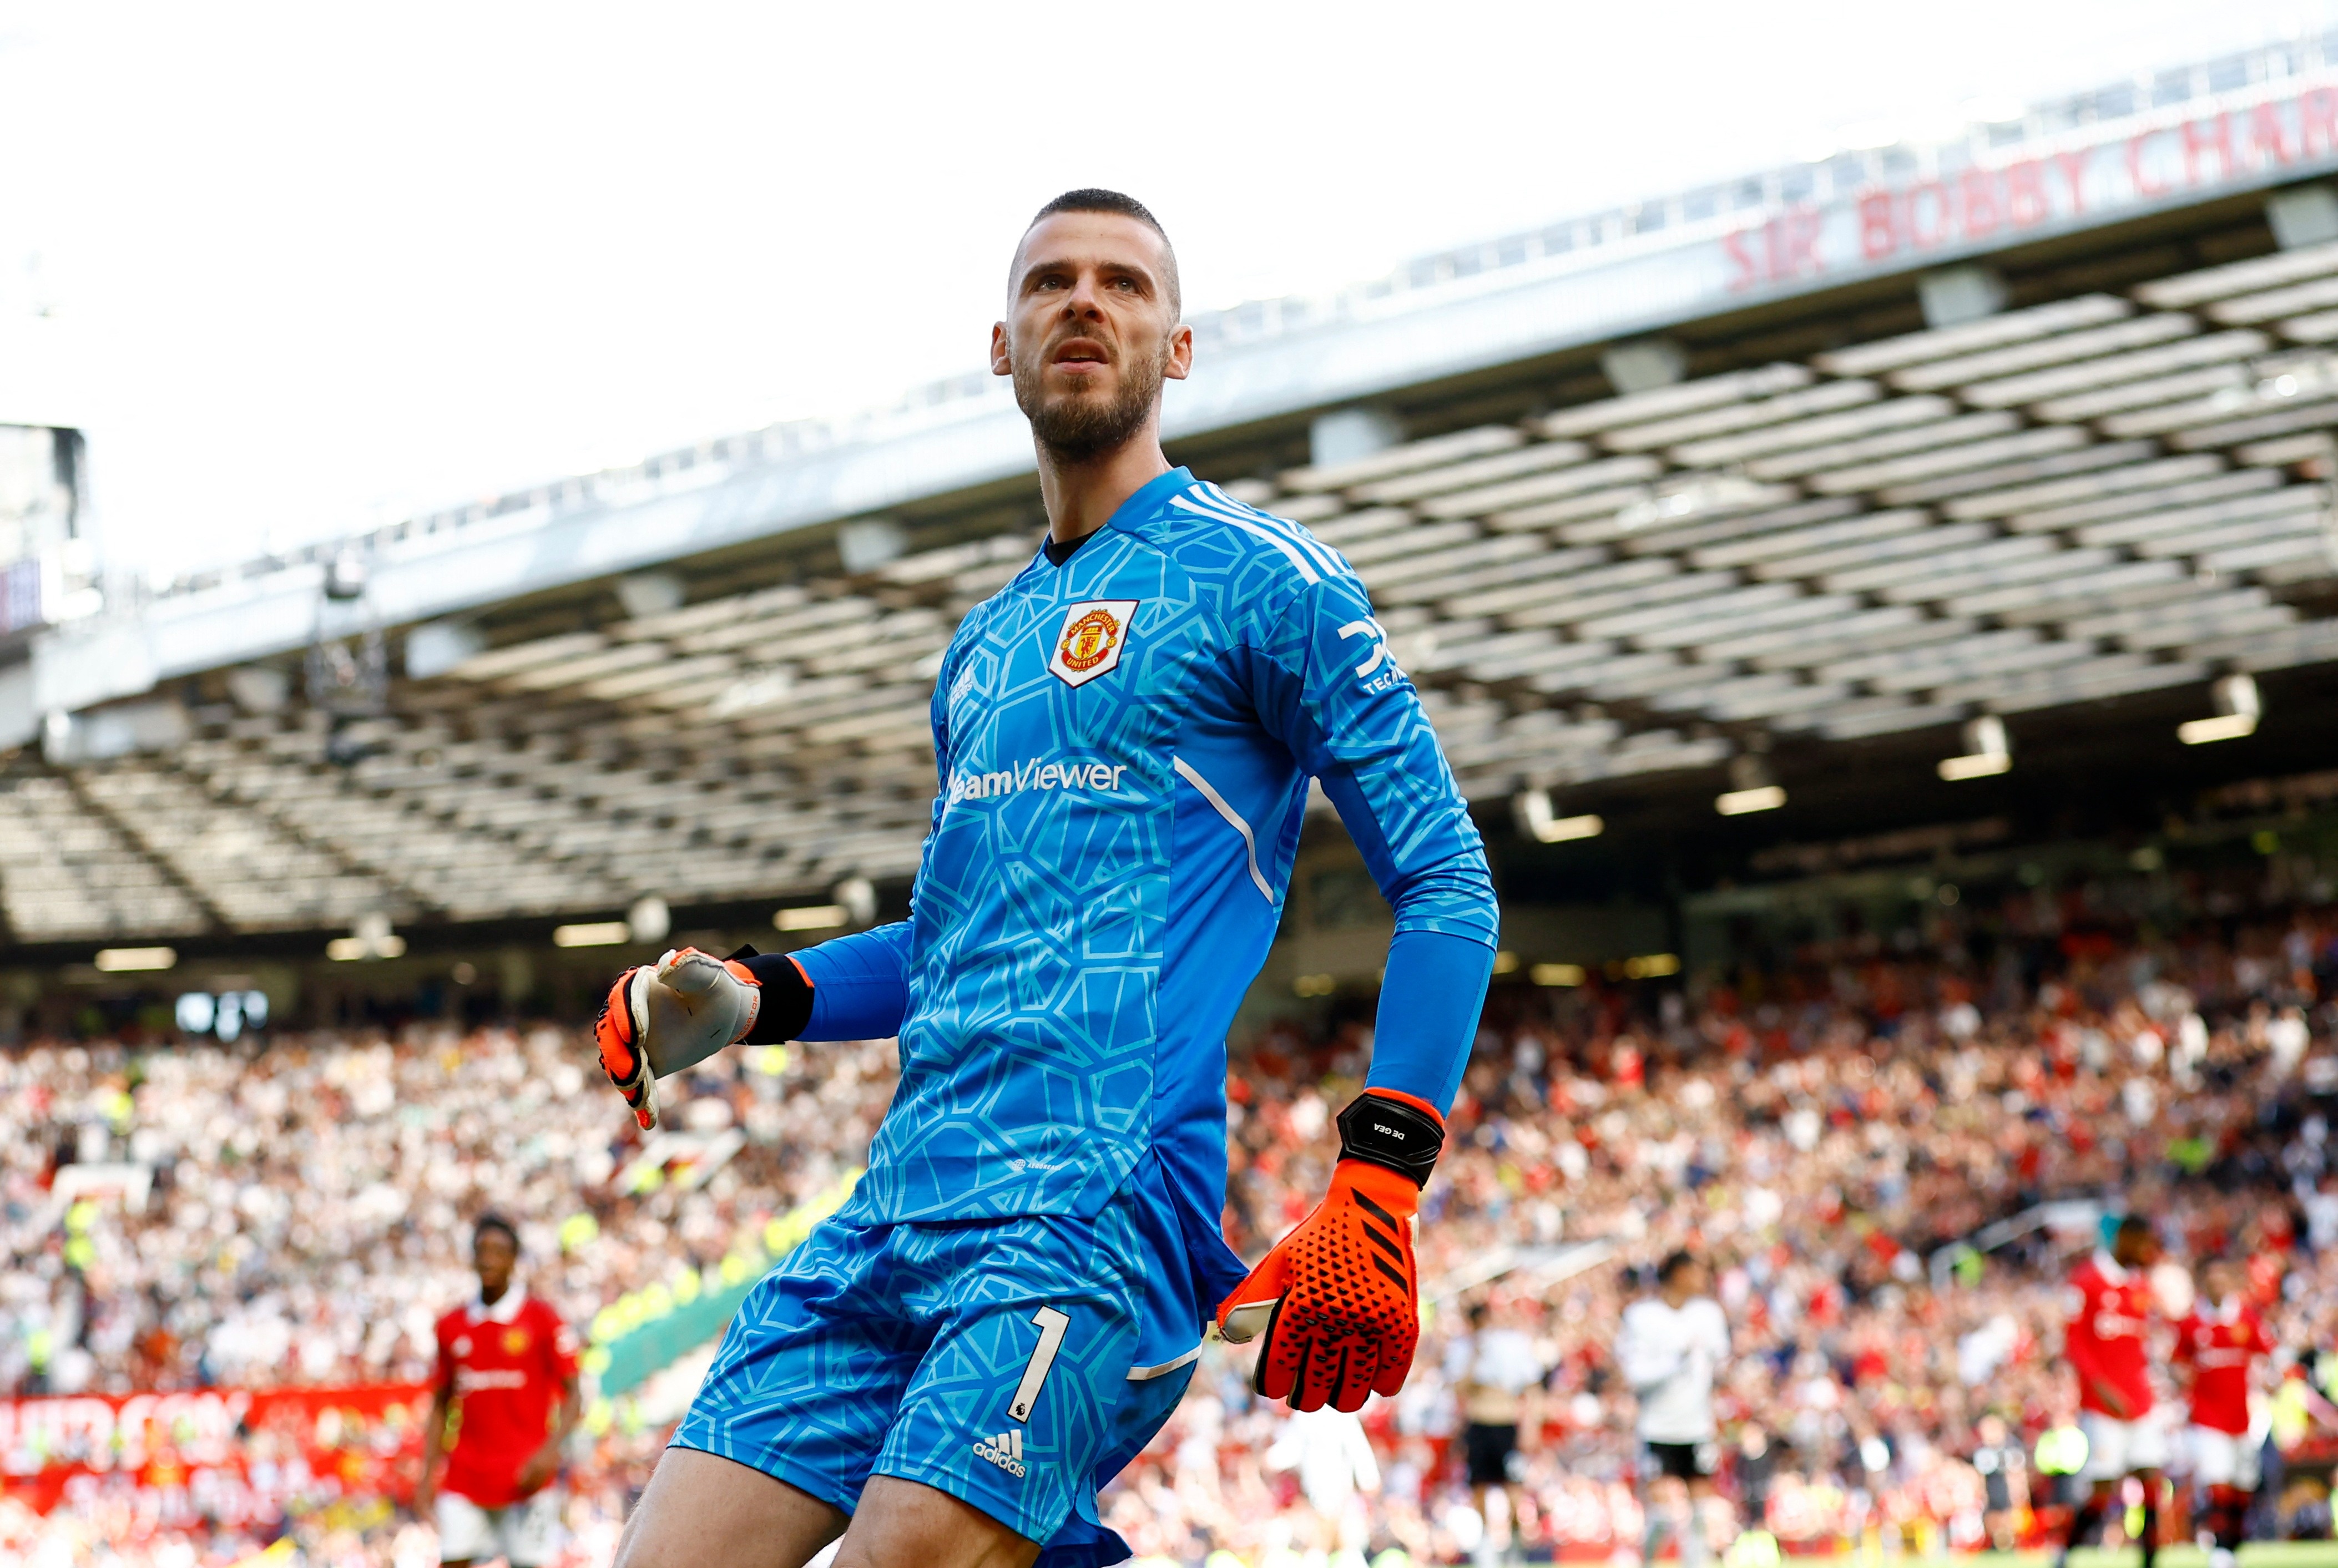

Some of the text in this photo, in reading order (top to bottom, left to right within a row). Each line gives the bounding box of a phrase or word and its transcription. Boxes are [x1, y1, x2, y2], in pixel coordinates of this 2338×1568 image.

[1720, 206, 1822, 293] SIR
[1856, 146, 2093, 262] BOBBY
[1070, 613, 1115, 634] MANCHESTER
[1067, 656, 1099, 668] UNITED
[1374, 1123, 1405, 1140] DE GEA
[1007, 1305, 1071, 1424] 1
[973, 1443, 1026, 1478] adidas
